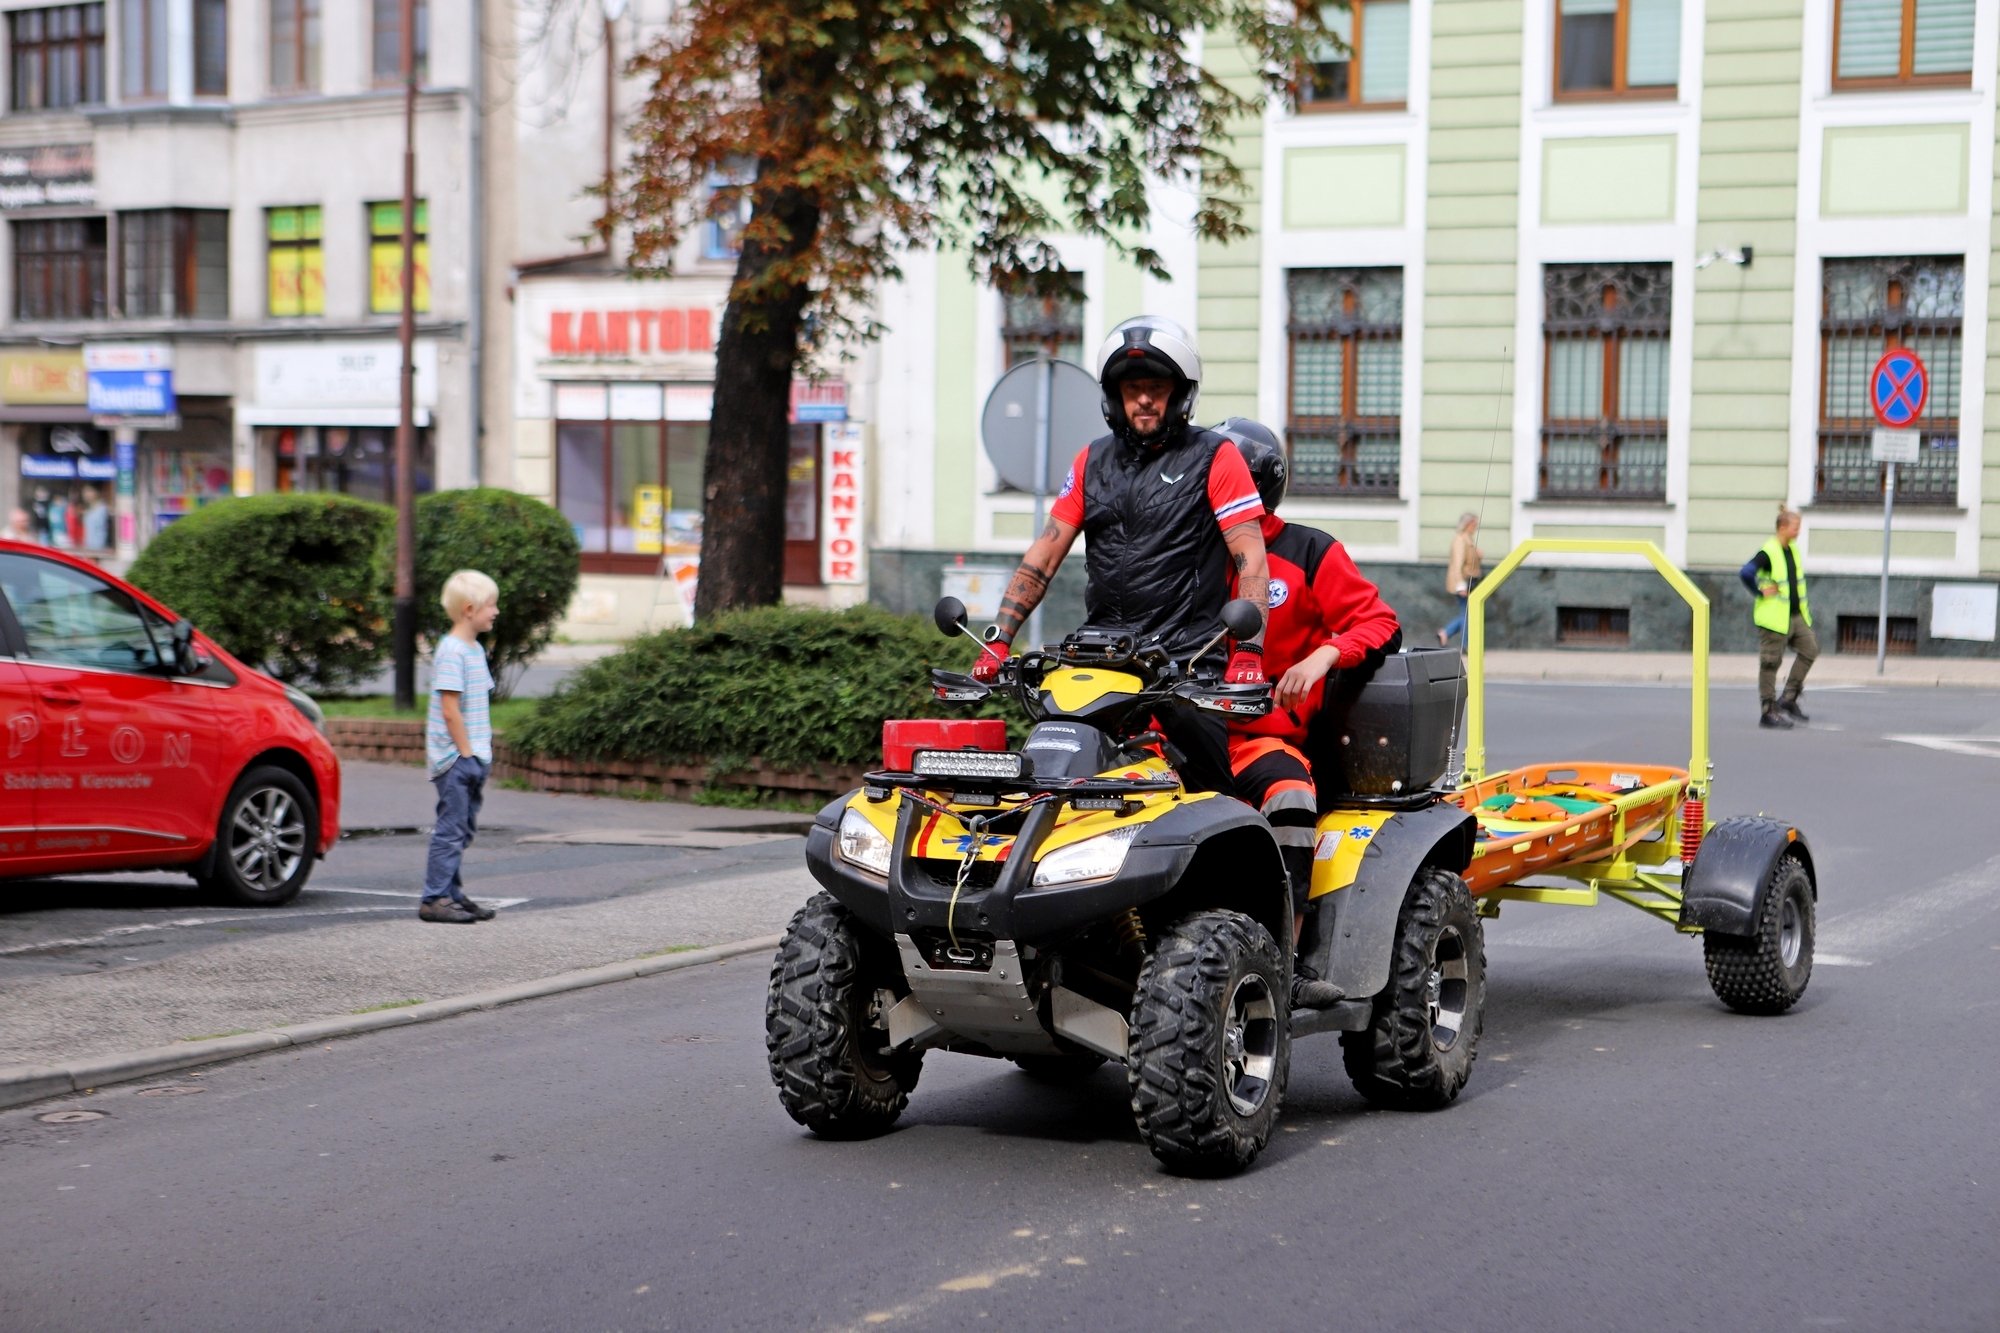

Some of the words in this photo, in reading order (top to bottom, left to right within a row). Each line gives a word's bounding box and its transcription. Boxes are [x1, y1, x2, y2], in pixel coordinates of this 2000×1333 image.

[550, 309, 712, 353] KANTOR
[831, 450, 857, 580] KANTOR
[971, 666, 989, 676] FOX
[1237, 671, 1263, 681] FOX
[1039, 726, 1077, 735] HONDA
[6, 711, 193, 769] PŁON
[4, 773, 73, 789] Szkolenia
[80, 772, 154, 789] Kierowców
